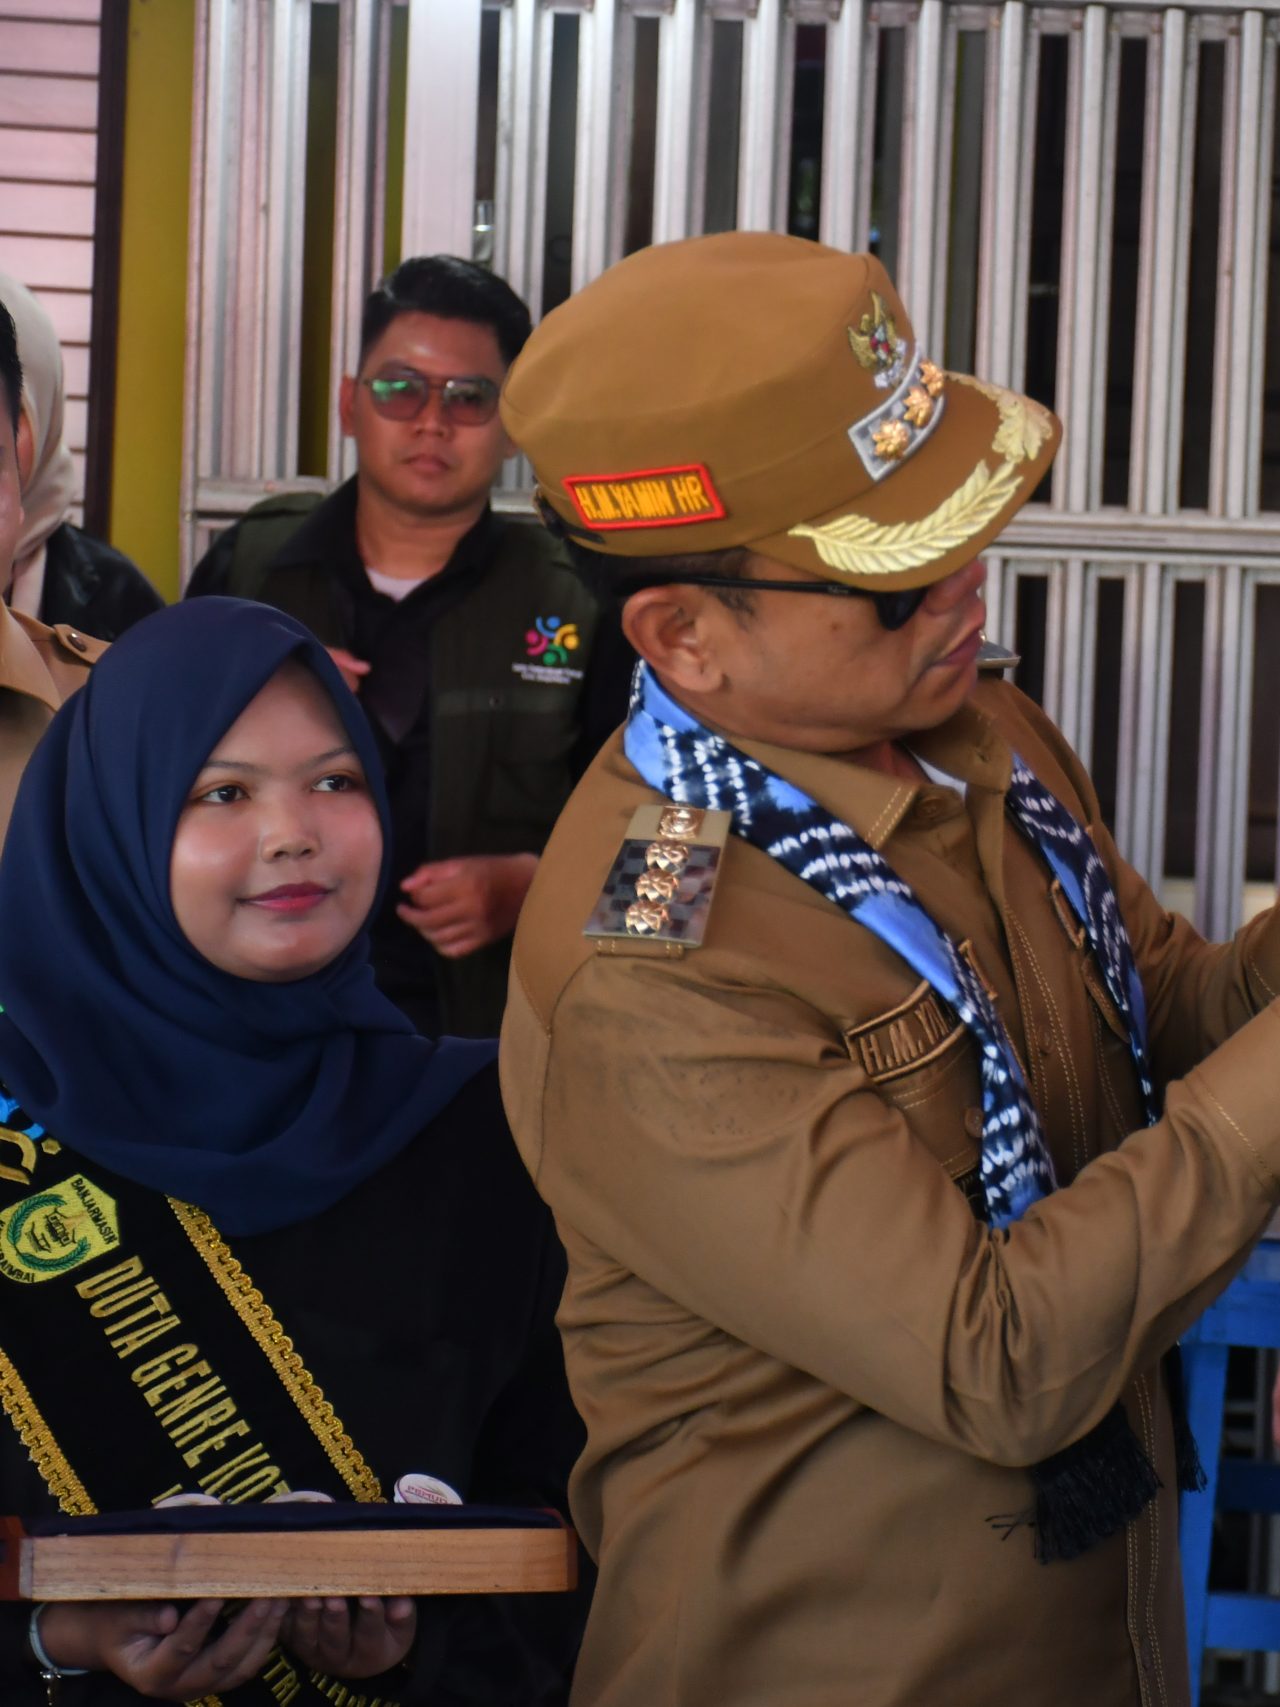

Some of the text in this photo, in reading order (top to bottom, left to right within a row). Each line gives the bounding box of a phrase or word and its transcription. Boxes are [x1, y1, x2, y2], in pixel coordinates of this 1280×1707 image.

[671, 474, 710, 514] HR
[70, 1177, 118, 1245] BANJARMASIN
[74, 1255, 182, 1360] DUTA
[130, 1343, 251, 1469] GENRE
